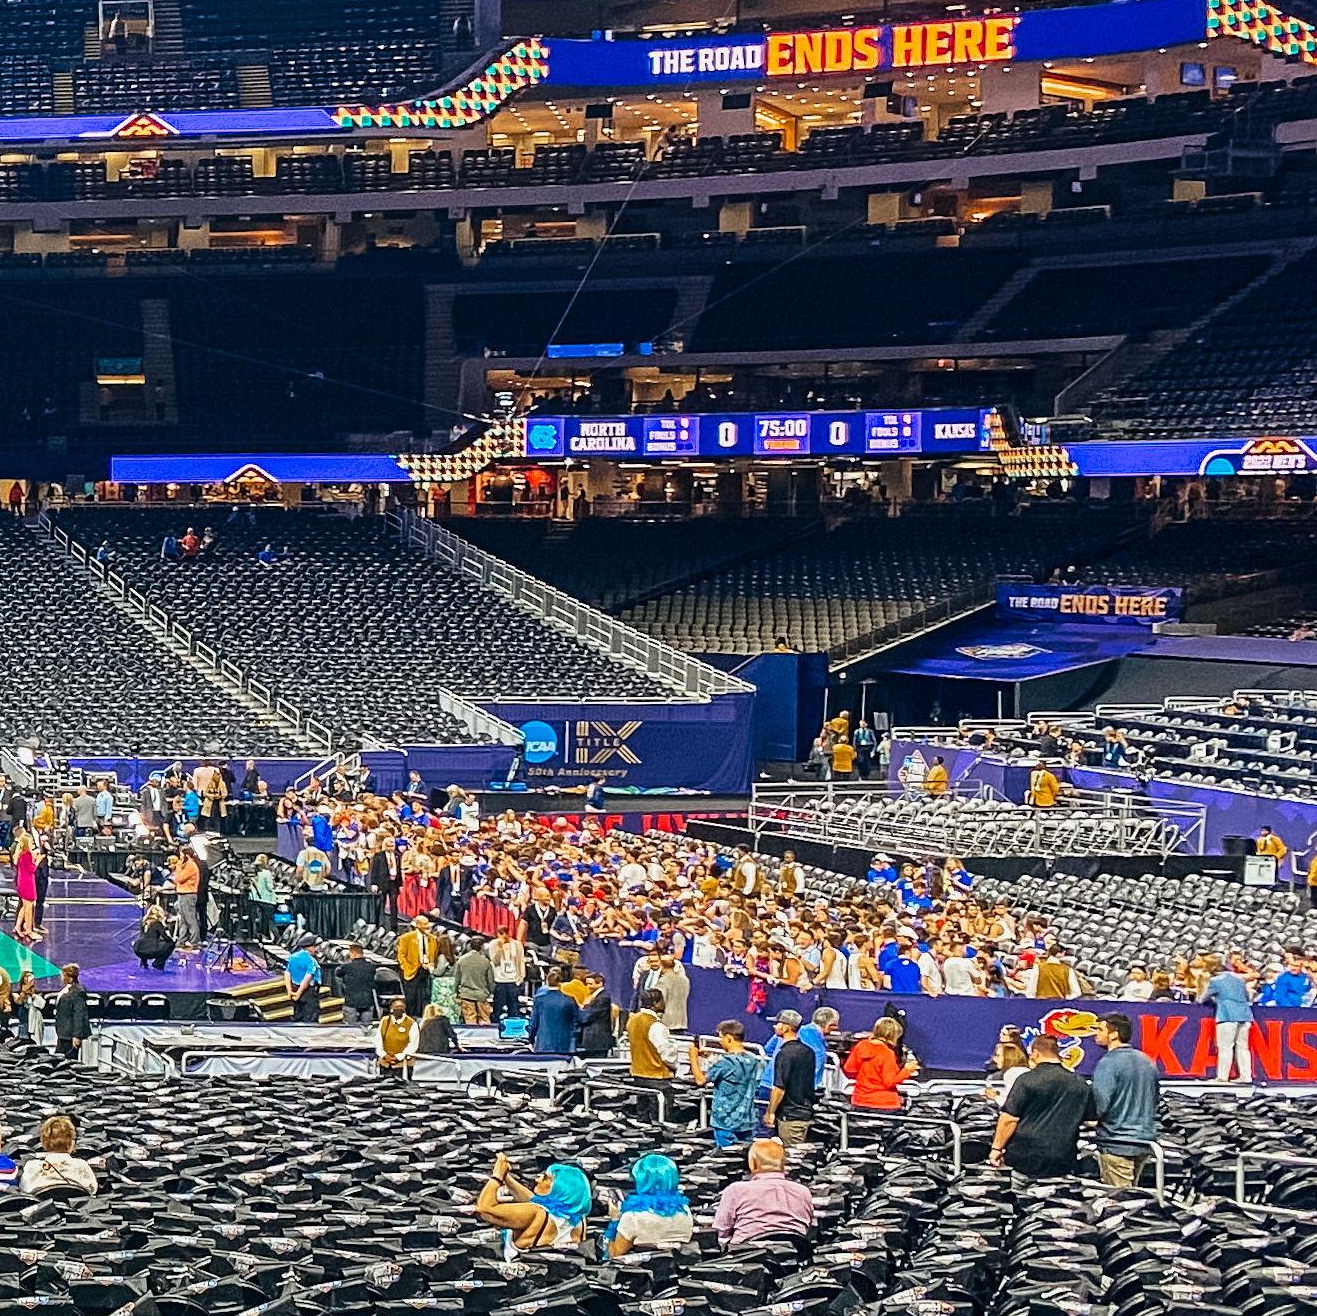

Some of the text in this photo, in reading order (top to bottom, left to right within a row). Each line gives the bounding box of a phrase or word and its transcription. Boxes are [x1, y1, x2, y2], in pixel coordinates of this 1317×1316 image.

[648, 17, 1015, 76] THE ROAD ENDS HERE
[580, 423, 627, 437] NORTH
[719, 422, 736, 447] 0
[758, 419, 807, 438] 75:00
[829, 421, 847, 446] 0
[570, 436, 637, 451] CAROLINA
[1009, 596, 1029, 609] THE
[1060, 594, 1110, 616] ENDS
[1114, 595, 1168, 617] HERE
[576, 737, 622, 748] TITLE
